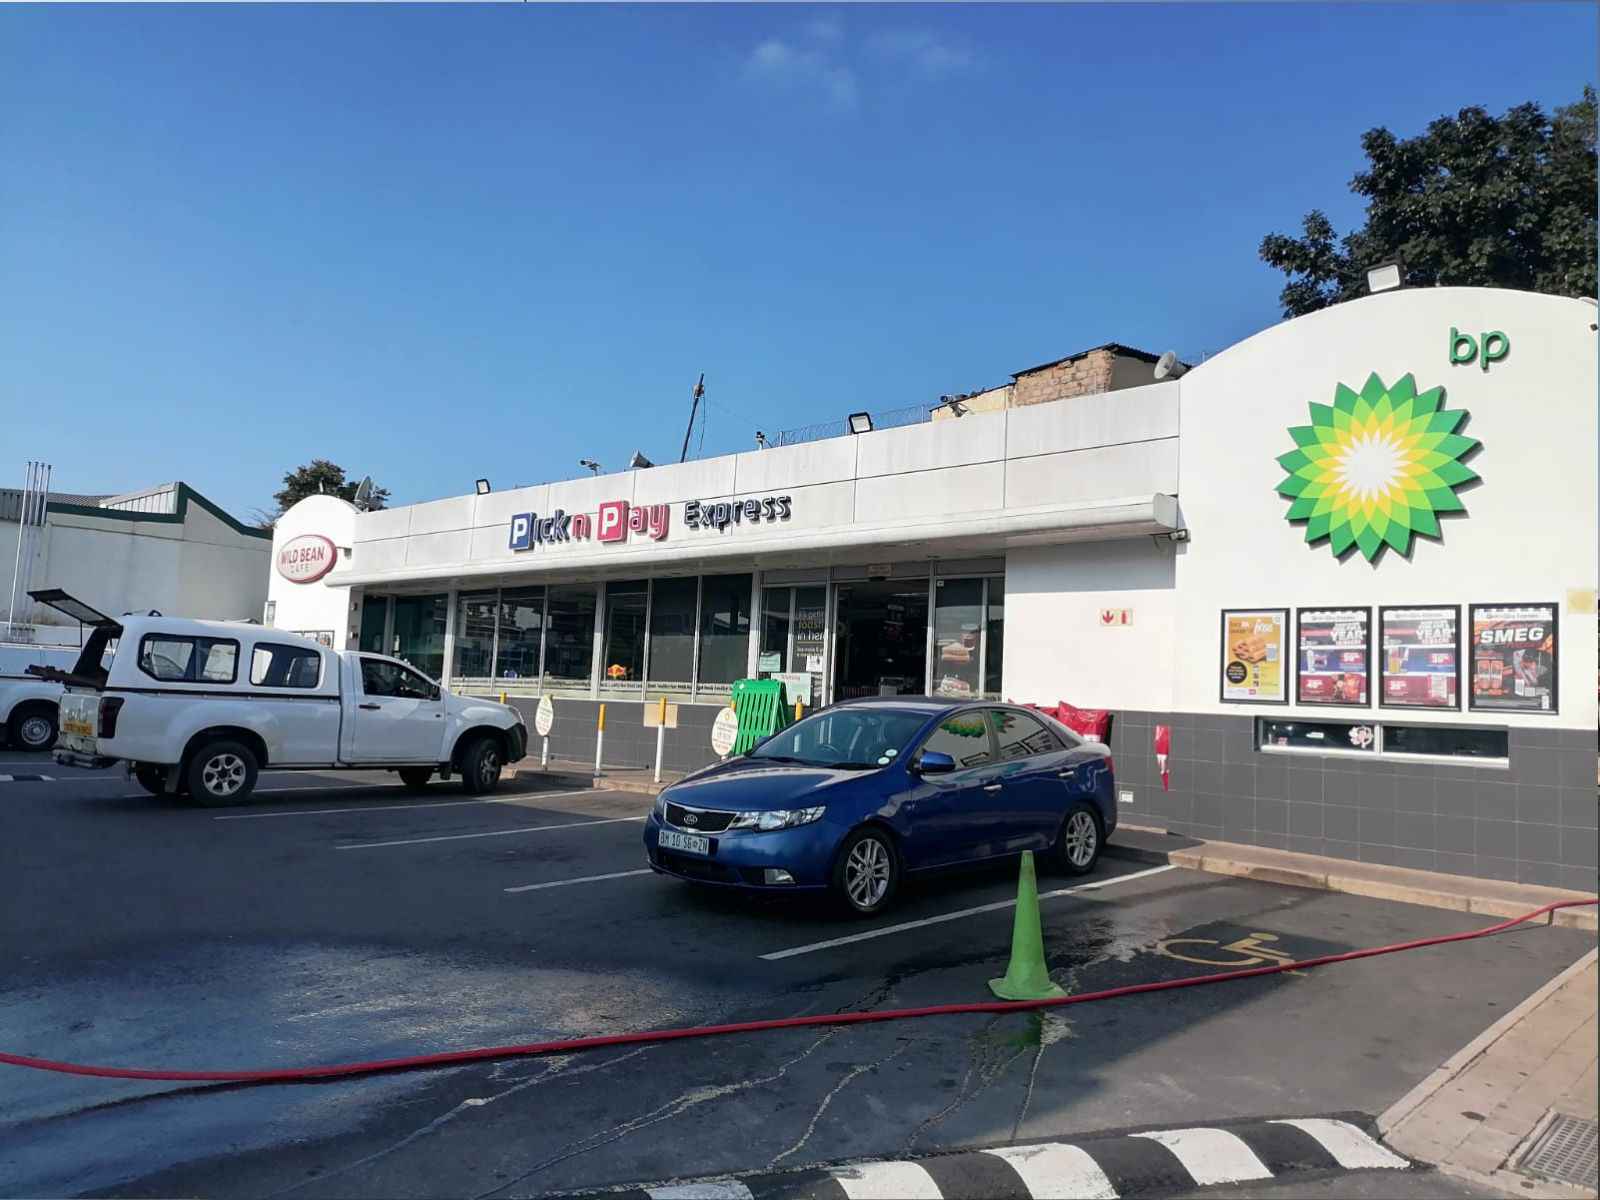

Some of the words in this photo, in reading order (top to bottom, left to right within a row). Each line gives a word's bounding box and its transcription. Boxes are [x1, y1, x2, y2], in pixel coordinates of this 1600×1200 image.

[1449, 326, 1510, 371] bp
[598, 500, 670, 542] Pay
[685, 496, 791, 532] Express
[281, 549, 298, 565] WILD
[300, 546, 325, 562] BEAN
[1331, 630, 1363, 641] YEAR
[1416, 628, 1452, 640] YEAR
[1480, 627, 1544, 643] SMEG
